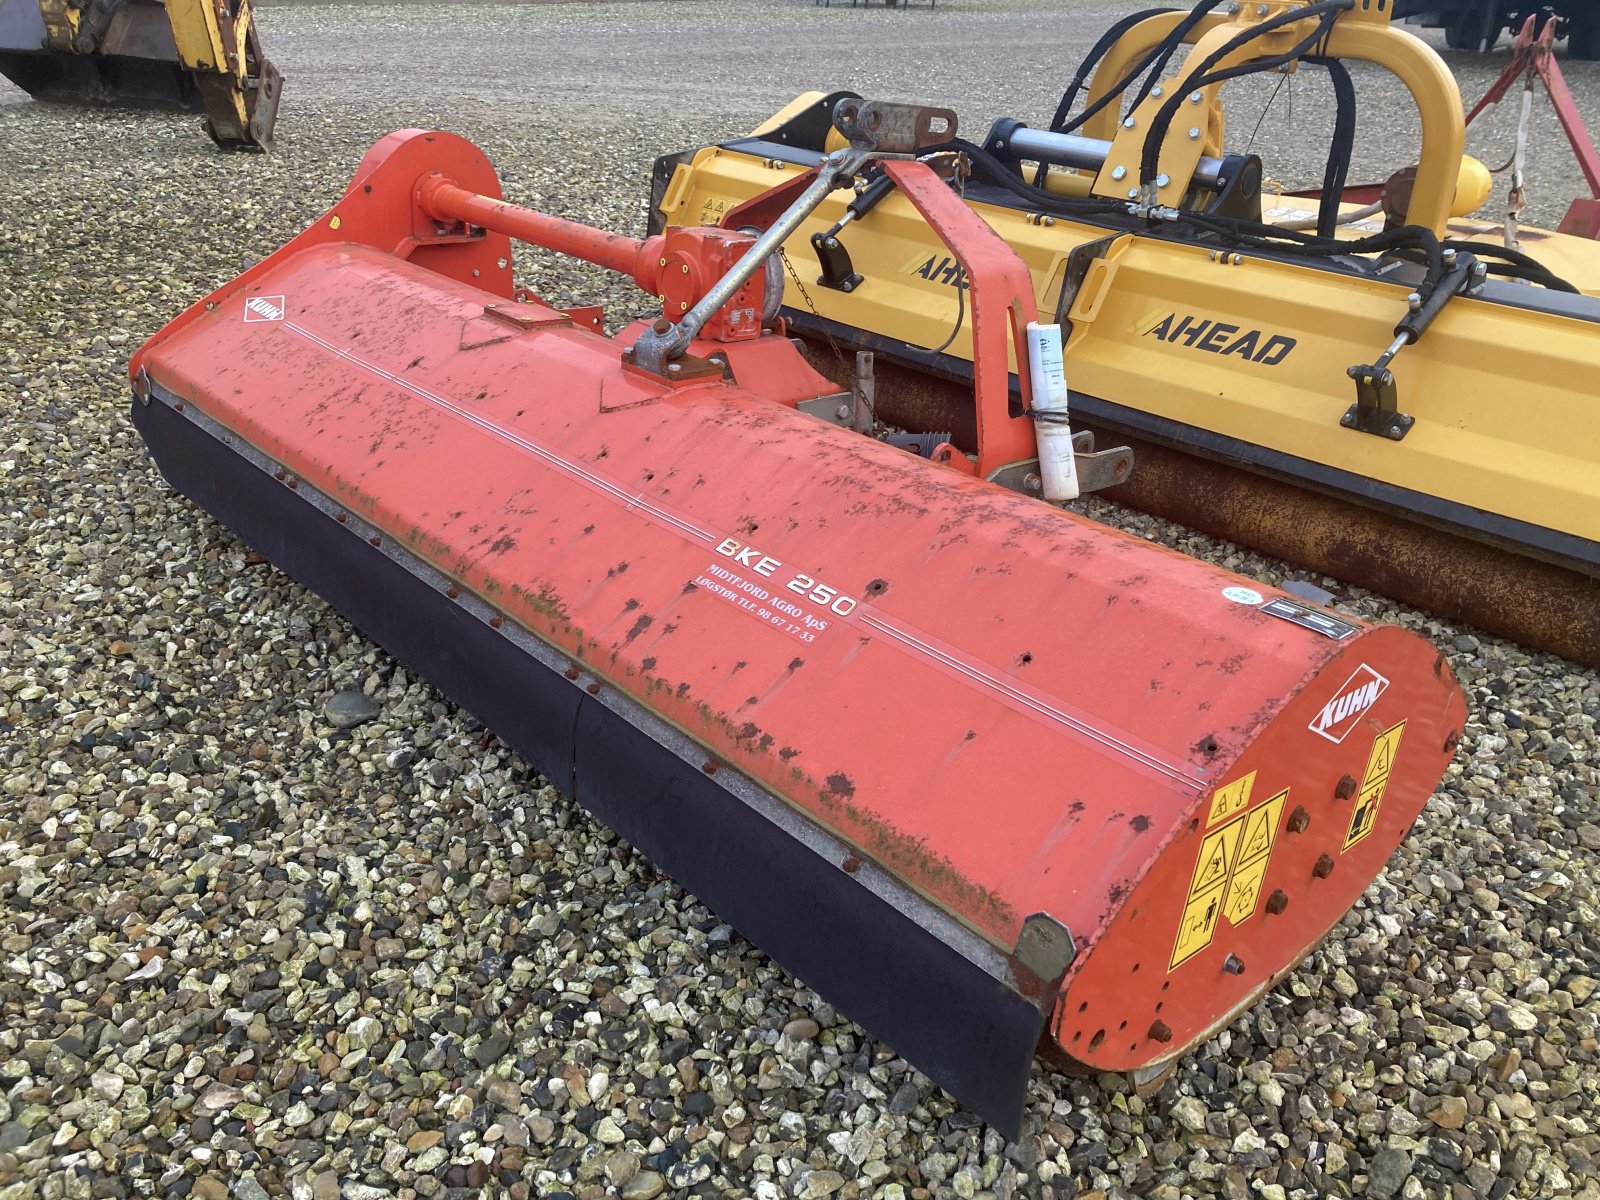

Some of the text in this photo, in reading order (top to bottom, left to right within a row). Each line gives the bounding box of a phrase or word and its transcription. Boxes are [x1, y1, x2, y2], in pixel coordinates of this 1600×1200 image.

[247, 298, 283, 320] KUHN
[1142, 312, 1297, 366] AHEAD
[706, 564, 828, 631] MIDTFJORD AGRO ApS
[715, 537, 858, 617] BKE 250
[695, 576, 738, 602] LØGSTØR
[756, 608, 772, 619] 98
[770, 616, 787, 627] 67
[785, 624, 801, 634] 17
[799, 631, 815, 643] 33
[1318, 677, 1381, 732] KUHN
